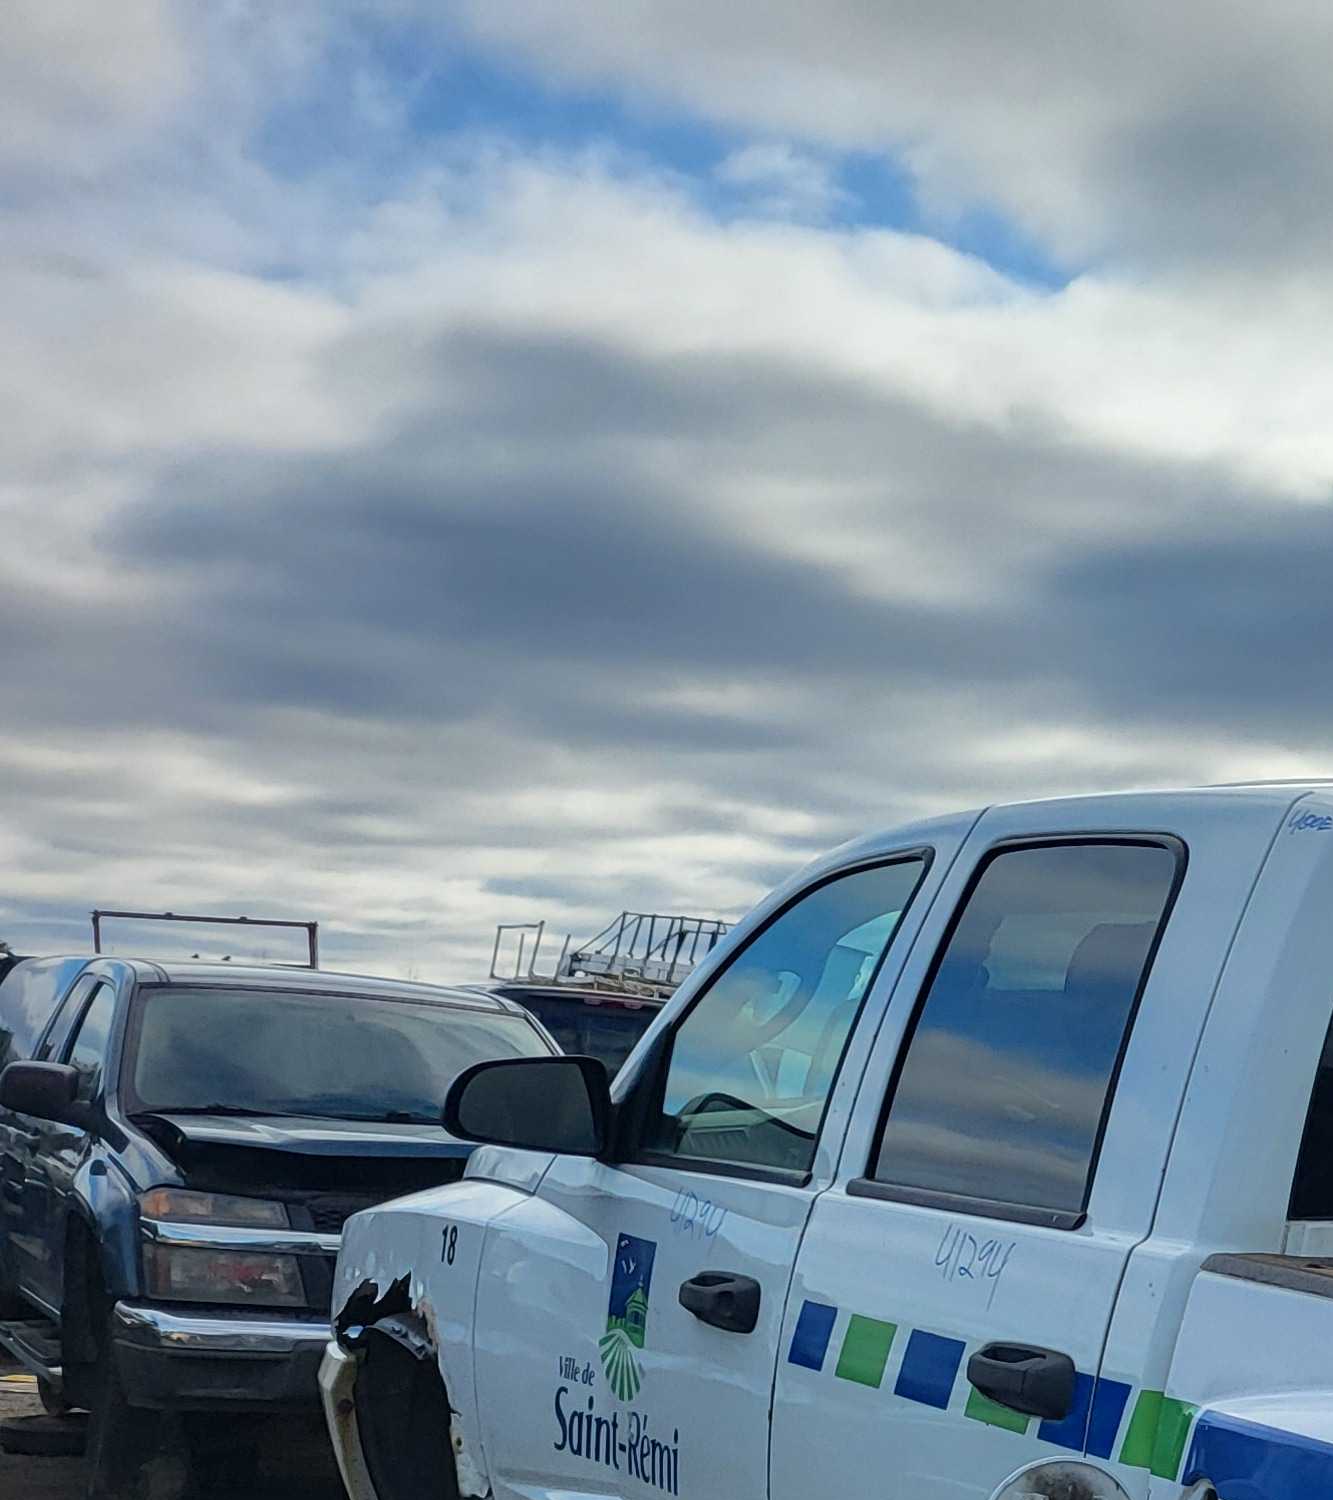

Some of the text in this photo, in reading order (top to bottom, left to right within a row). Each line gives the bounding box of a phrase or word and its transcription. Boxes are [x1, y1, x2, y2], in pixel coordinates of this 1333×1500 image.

[441, 1224, 458, 1266] 18
[935, 1223, 1017, 1312] 41294
[581, 1362, 595, 1386] de
[554, 1386, 679, 1496] Saint-Rémi
